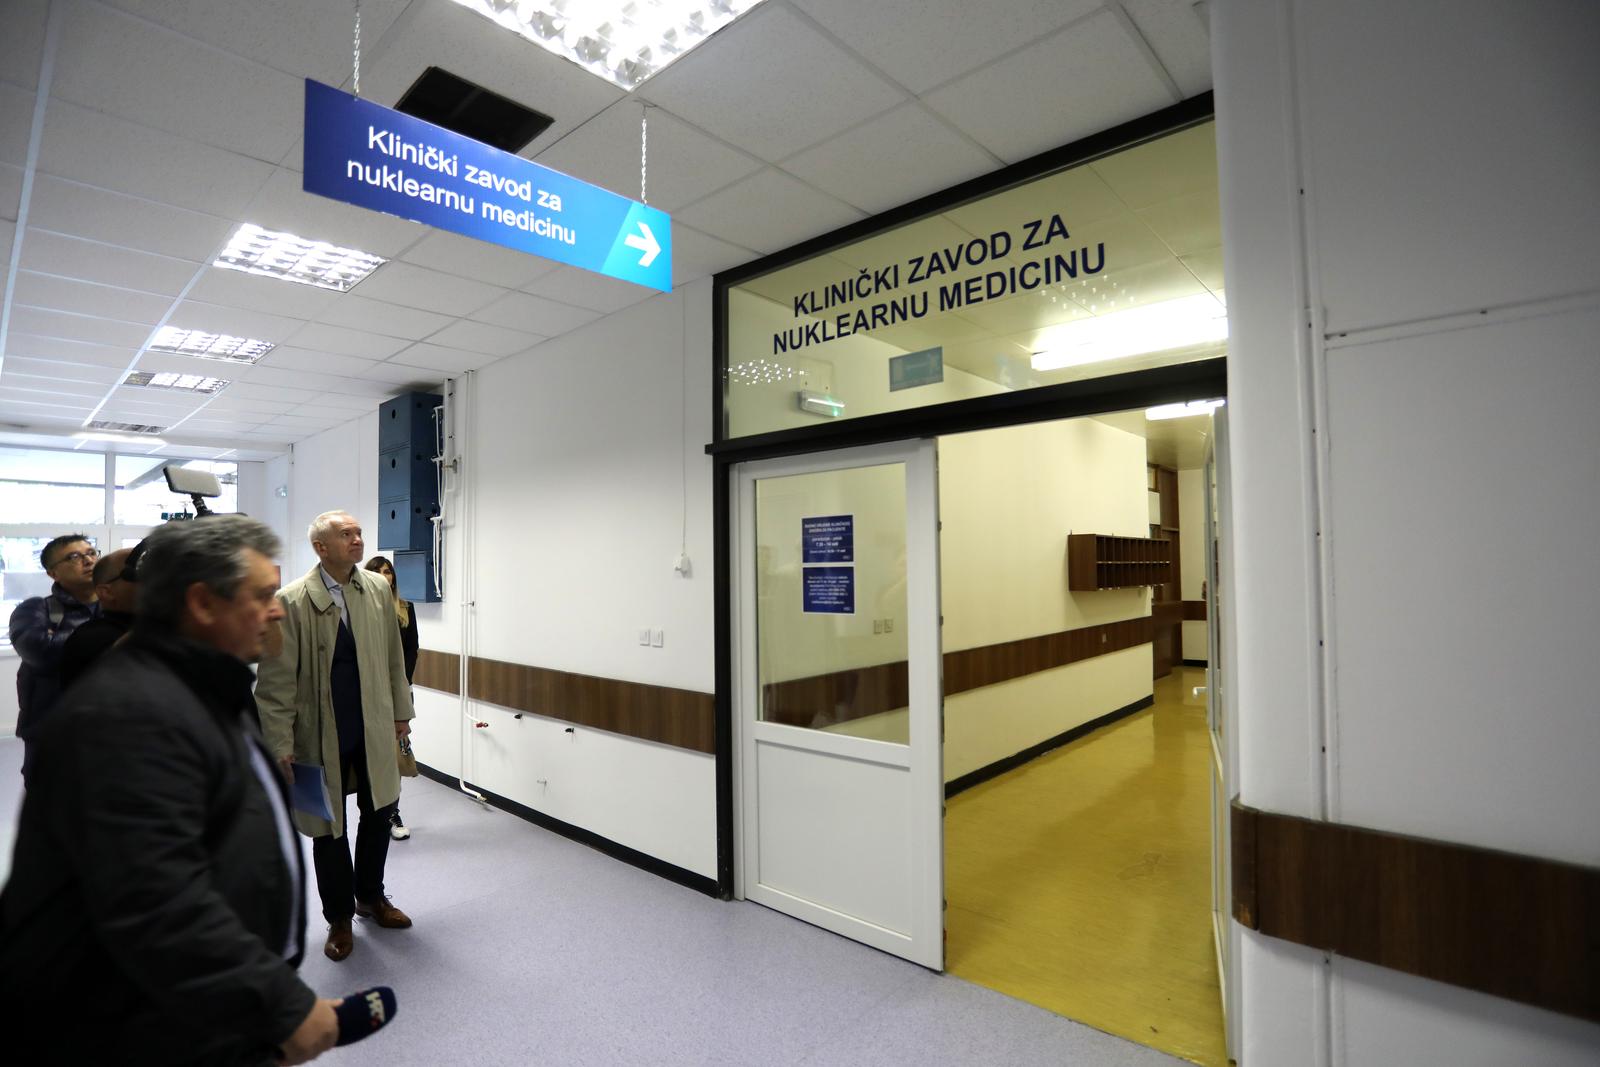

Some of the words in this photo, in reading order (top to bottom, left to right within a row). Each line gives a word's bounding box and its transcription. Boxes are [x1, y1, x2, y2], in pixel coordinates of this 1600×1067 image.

[347, 160, 474, 214] nuklearnu
[482, 201, 576, 245] medicinu
[368, 126, 458, 177] Klinički
[464, 164, 531, 202] zavod
[537, 188, 562, 212] za
[773, 291, 928, 355] NUKLEARNU
[940, 242, 1105, 312] MEDICINU
[793, 264, 899, 318] KLINIČKI
[907, 231, 1012, 284] ZAVOD
[1022, 214, 1070, 251] ZA
